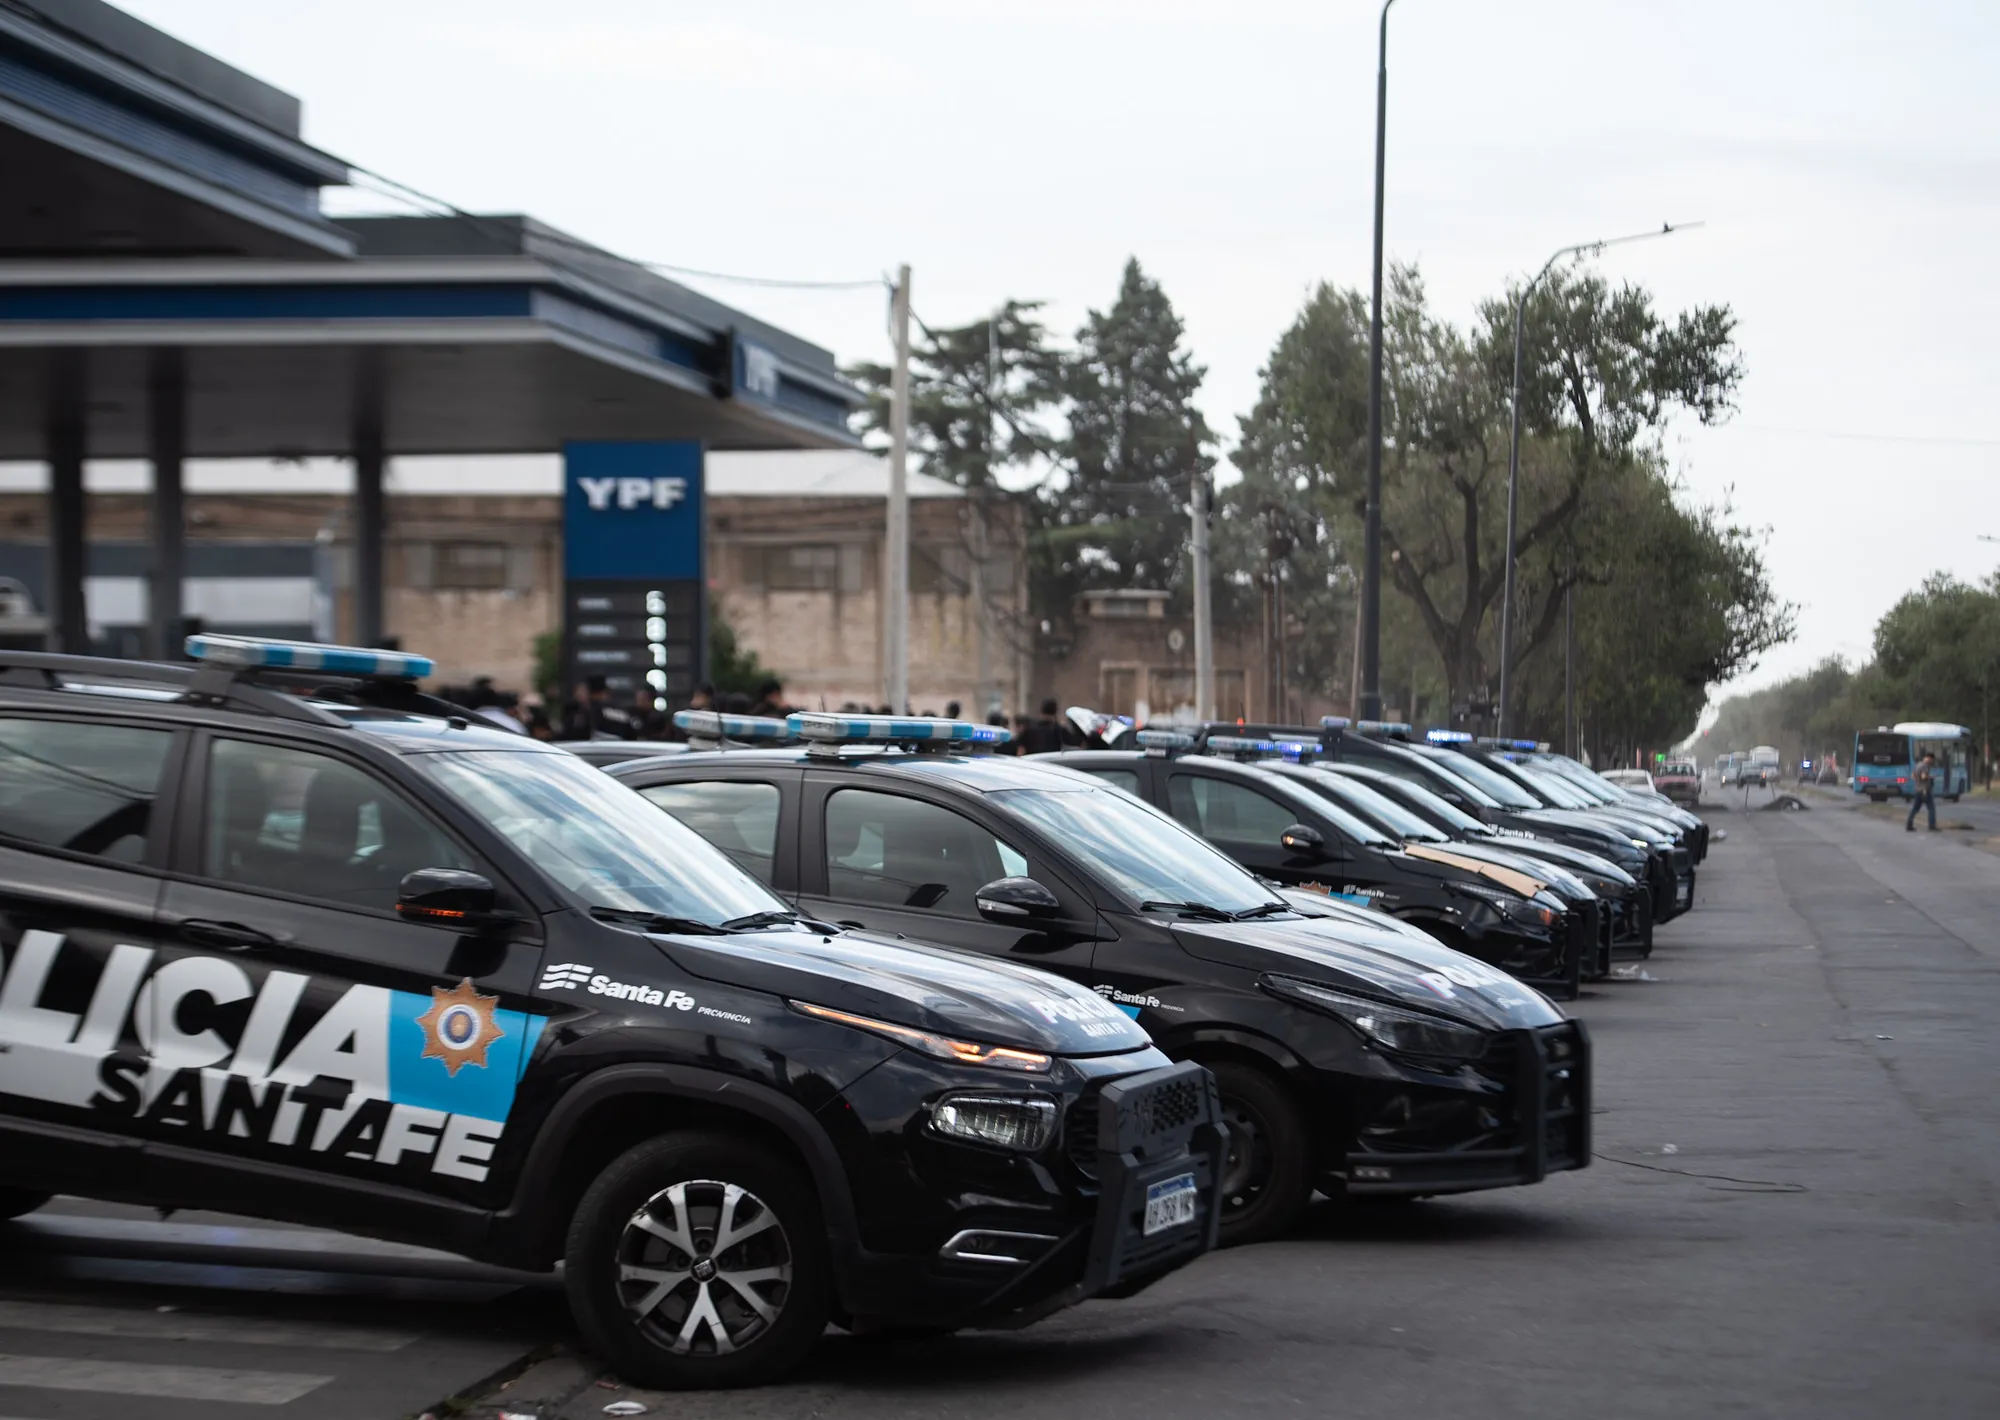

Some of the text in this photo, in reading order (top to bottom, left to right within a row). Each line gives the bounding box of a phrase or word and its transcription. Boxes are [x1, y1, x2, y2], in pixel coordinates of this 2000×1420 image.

[576, 477, 688, 511] YPF
[0, 929, 391, 1101] LICIA
[587, 975, 752, 1025] Santa Fe PROVINCIA
[1113, 990, 1185, 1012] Santa Fe PROVINCIA
